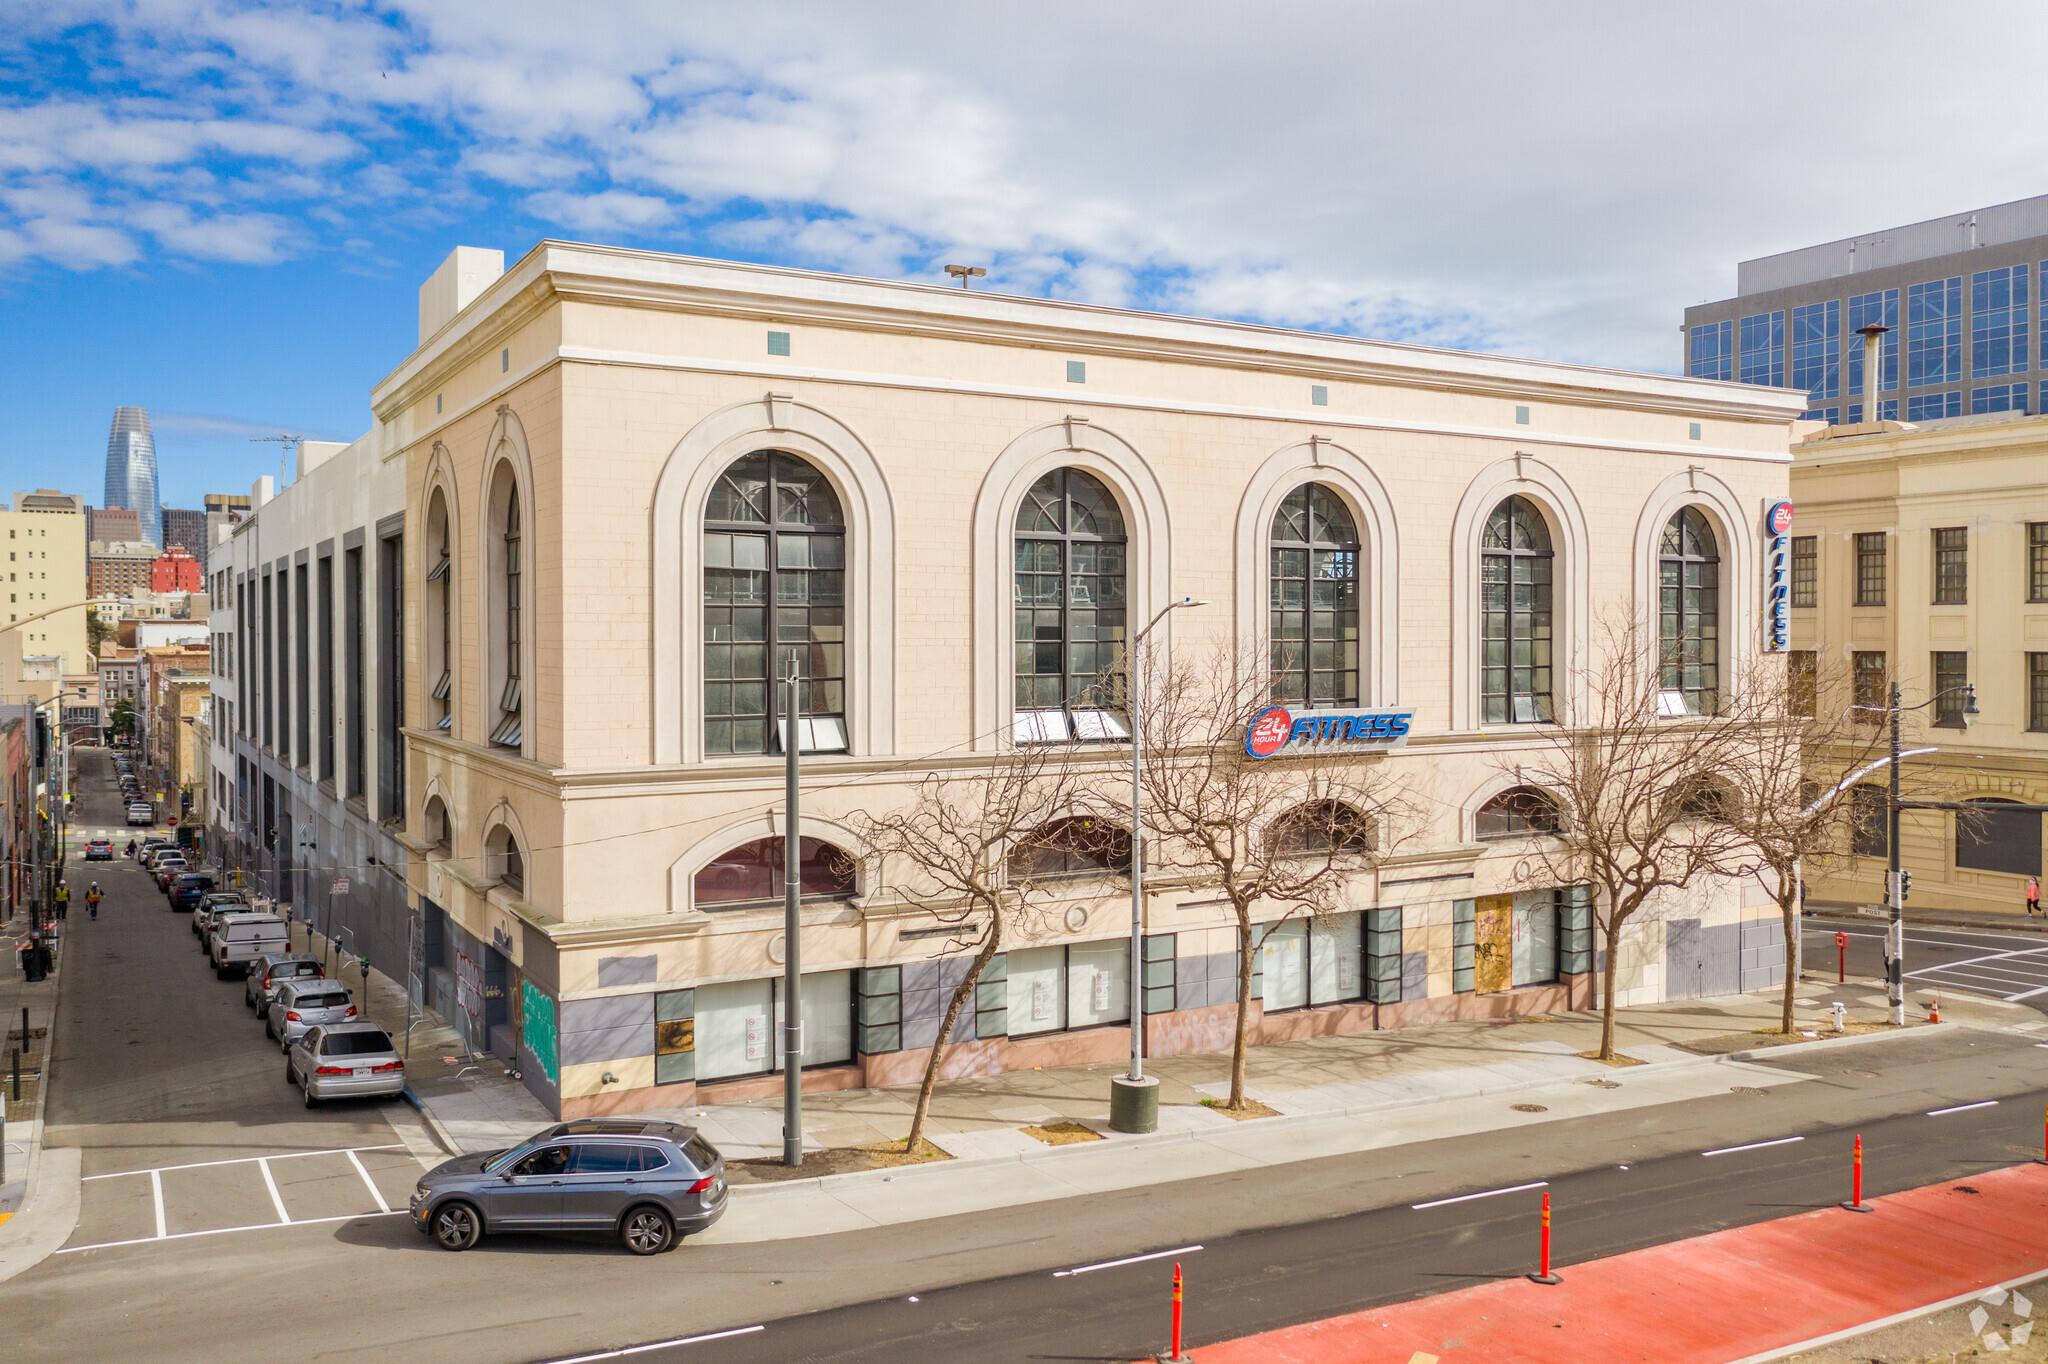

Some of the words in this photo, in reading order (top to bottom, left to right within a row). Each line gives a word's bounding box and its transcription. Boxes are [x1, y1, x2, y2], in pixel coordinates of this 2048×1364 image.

[1776, 508, 1792, 524] 24
[1775, 536, 1788, 647] FITNESS
[1255, 717, 1289, 742] 24
[1291, 713, 1412, 741] FITNESS
[1253, 735, 1277, 744] HOUR
[1865, 909, 1881, 917] POST
